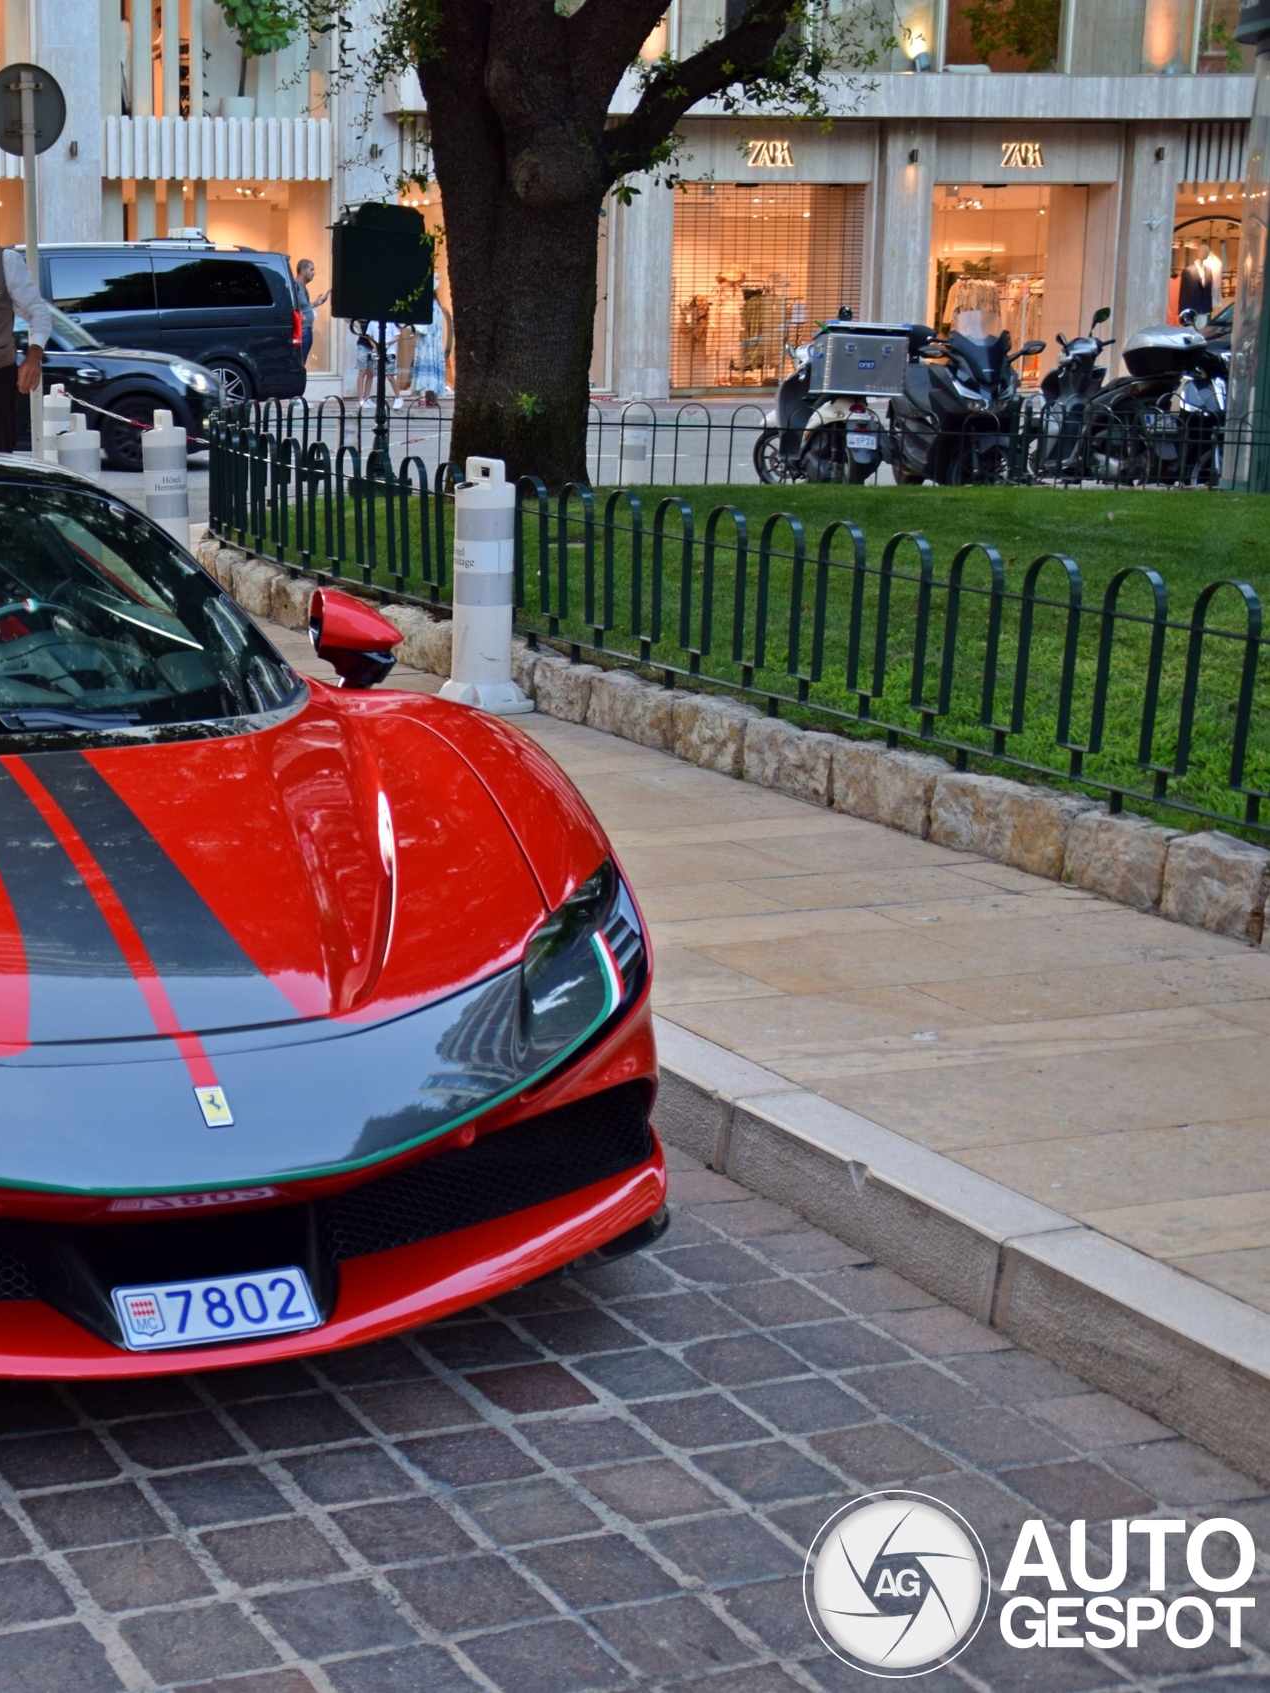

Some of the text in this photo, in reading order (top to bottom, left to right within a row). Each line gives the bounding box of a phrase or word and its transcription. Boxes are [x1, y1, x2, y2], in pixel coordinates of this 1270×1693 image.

[747, 141, 795, 167] ZARA
[1000, 142, 1044, 168] ZARA
[162, 475, 181, 484] Hôtel
[165, 1278, 305, 1334] 7802
[136, 1317, 158, 1331] MC
